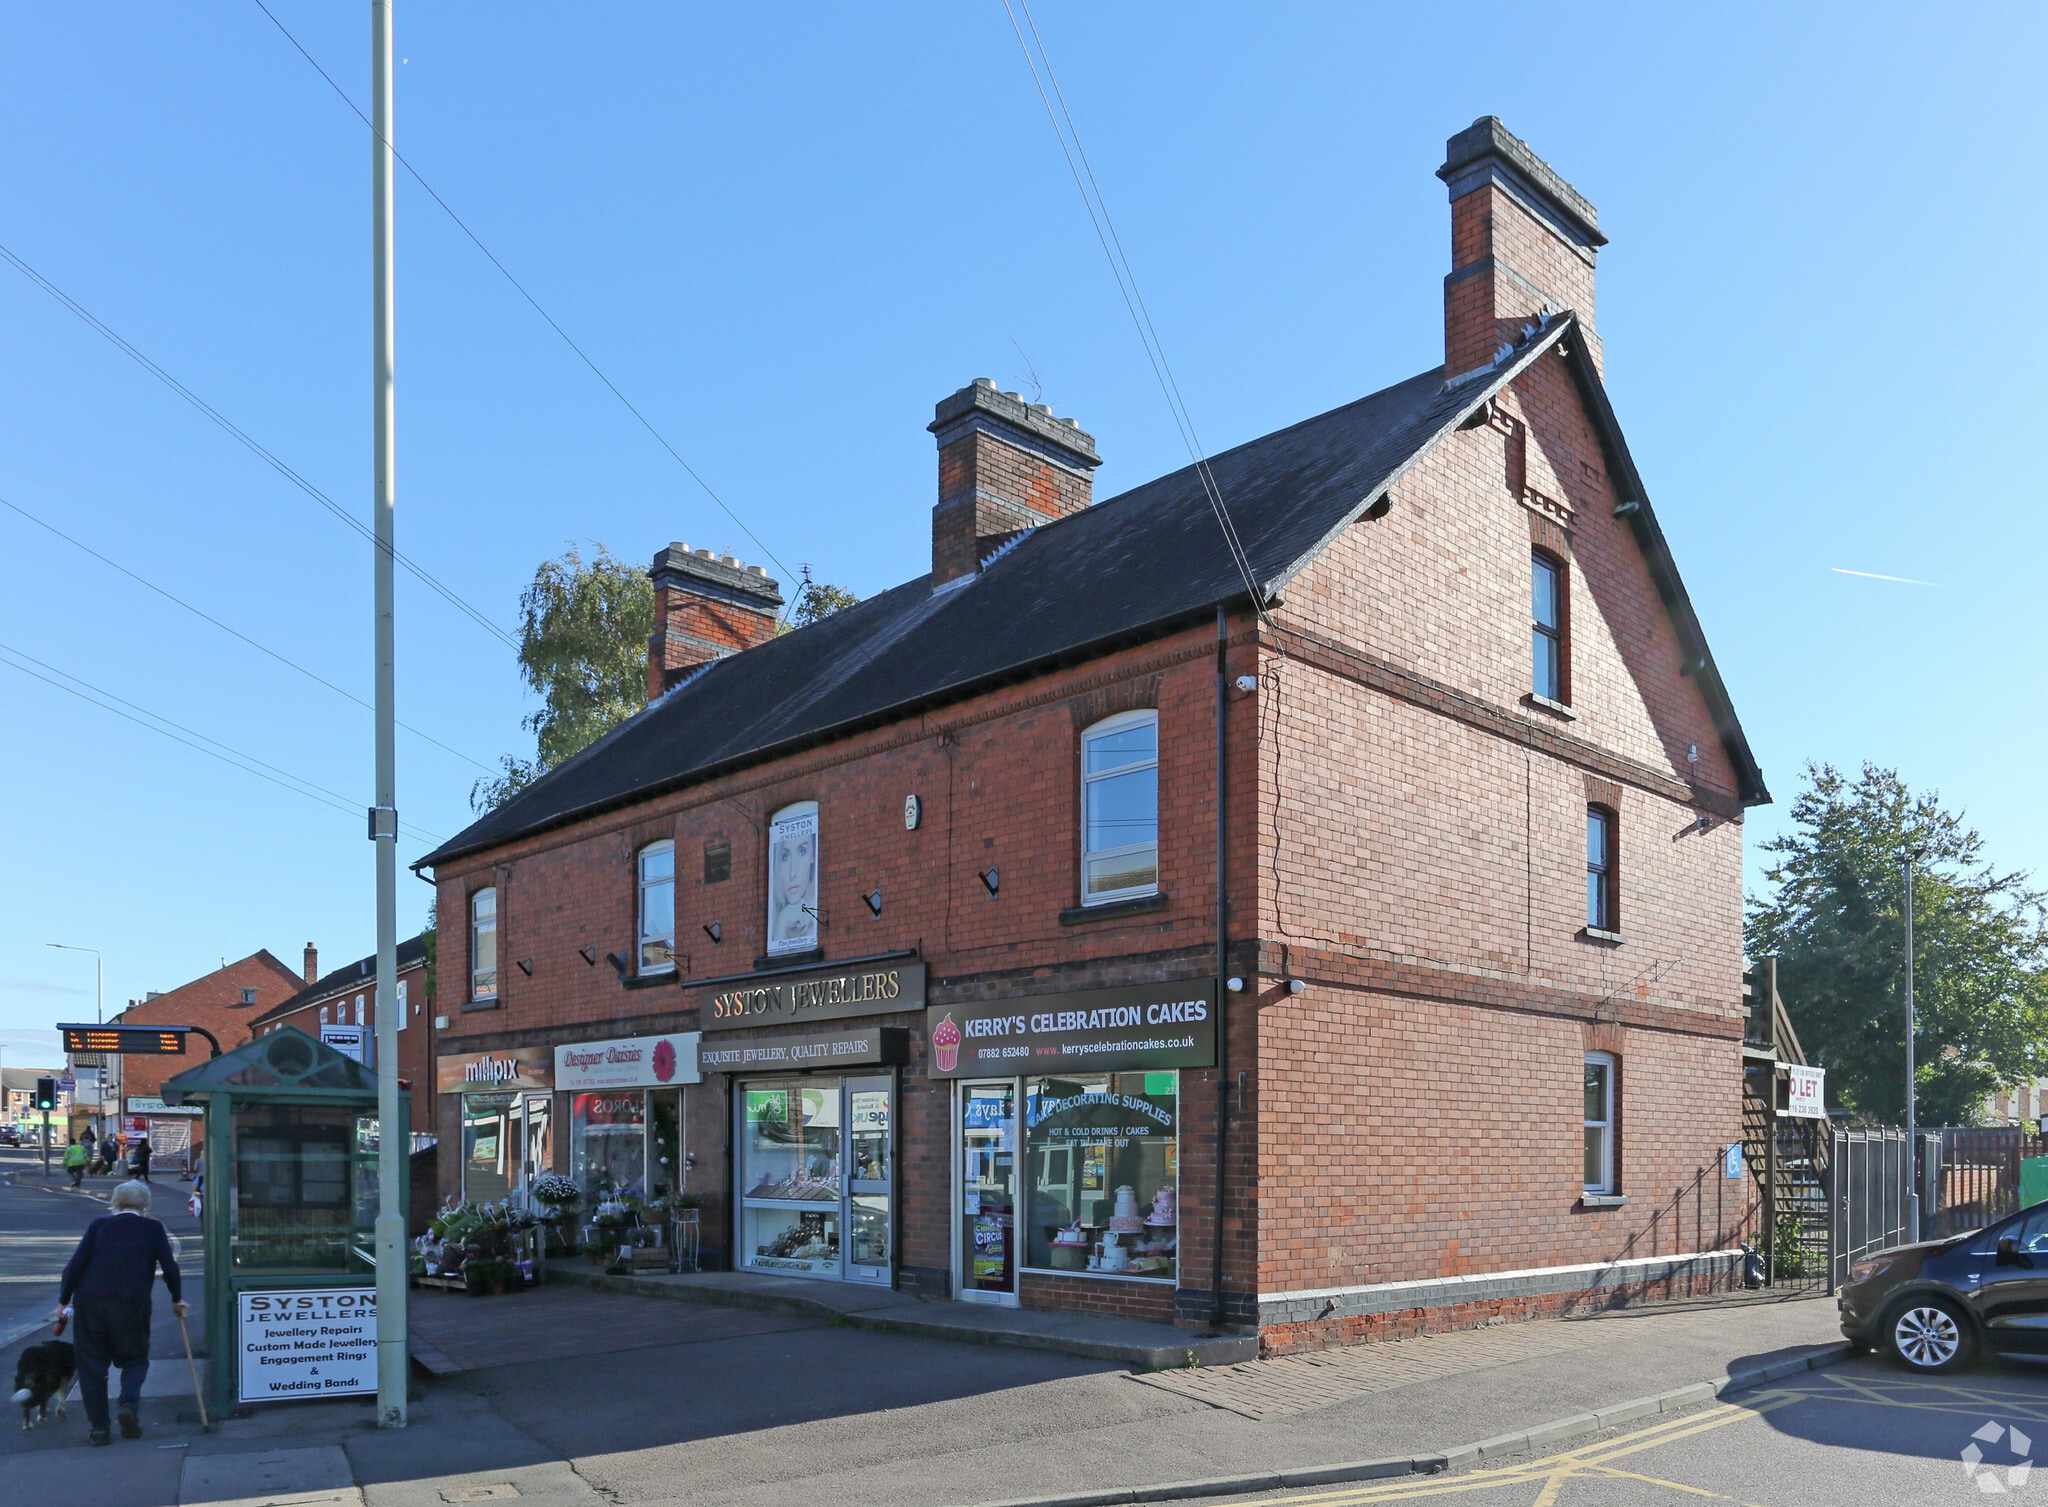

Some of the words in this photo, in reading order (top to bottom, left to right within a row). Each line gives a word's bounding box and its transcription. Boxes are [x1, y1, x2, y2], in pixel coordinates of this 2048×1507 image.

[779, 819, 812, 835] SYSTON
[779, 828, 813, 842] JEWELLERS
[714, 986, 783, 1019] SYSTON
[789, 970, 900, 1016] JEWELLERS
[965, 1015, 1026, 1038] KERRY'S
[1030, 1005, 1141, 1034] CELEBRATION
[1146, 1000, 1207, 1025] CAKES
[702, 1050, 740, 1065] EXQUISITE
[743, 1047, 789, 1064] JEWELLERY,
[791, 1043, 829, 1061] QUALITY
[832, 1039, 869, 1055] REPAIRS
[978, 1048, 1000, 1059] 07882
[1002, 1046, 1029, 1058] 652480
[1035, 1045, 1060, 1056] www.
[1062, 1035, 1194, 1056] kerryscelebrationcakes.co.uk
[564, 1048, 604, 1072] Designer
[606, 1044, 643, 1063] Daisies
[465, 1056, 519, 1086] millipix
[1800, 1079, 1817, 1098] LET
[1055, 1093, 1120, 1112] DECORATING
[1122, 1095, 1172, 1126] SUPPLIES
[1049, 1128, 1062, 1136] HOT
[1064, 1127, 1070, 1136] &
[1072, 1127, 1090, 1136] COLD
[1091, 1127, 1118, 1136] DRINKS
[1125, 1127, 1149, 1135] CAKES
[1065, 1139, 1079, 1148] EAT
[1080, 1139, 1089, 1147] IN
[1095, 1139, 1113, 1148] TAKE
[1115, 1139, 1129, 1147] OUT
[976, 1231, 1002, 1245] CIRCUS
[250, 1295, 376, 1311] SYSTON
[245, 1309, 378, 1323] JEWELLERS
[265, 1327, 317, 1339] Jewellery
[321, 1325, 362, 1337] Repairs
[247, 1343, 290, 1352] Custom
[294, 1340, 326, 1350] Made
[329, 1338, 378, 1349] Jewellery
[260, 1353, 334, 1366] Engagement
[337, 1351, 367, 1362] Rings
[310, 1366, 319, 1376] &
[269, 1380, 321, 1391] Wedding
[325, 1377, 359, 1388] Bands
